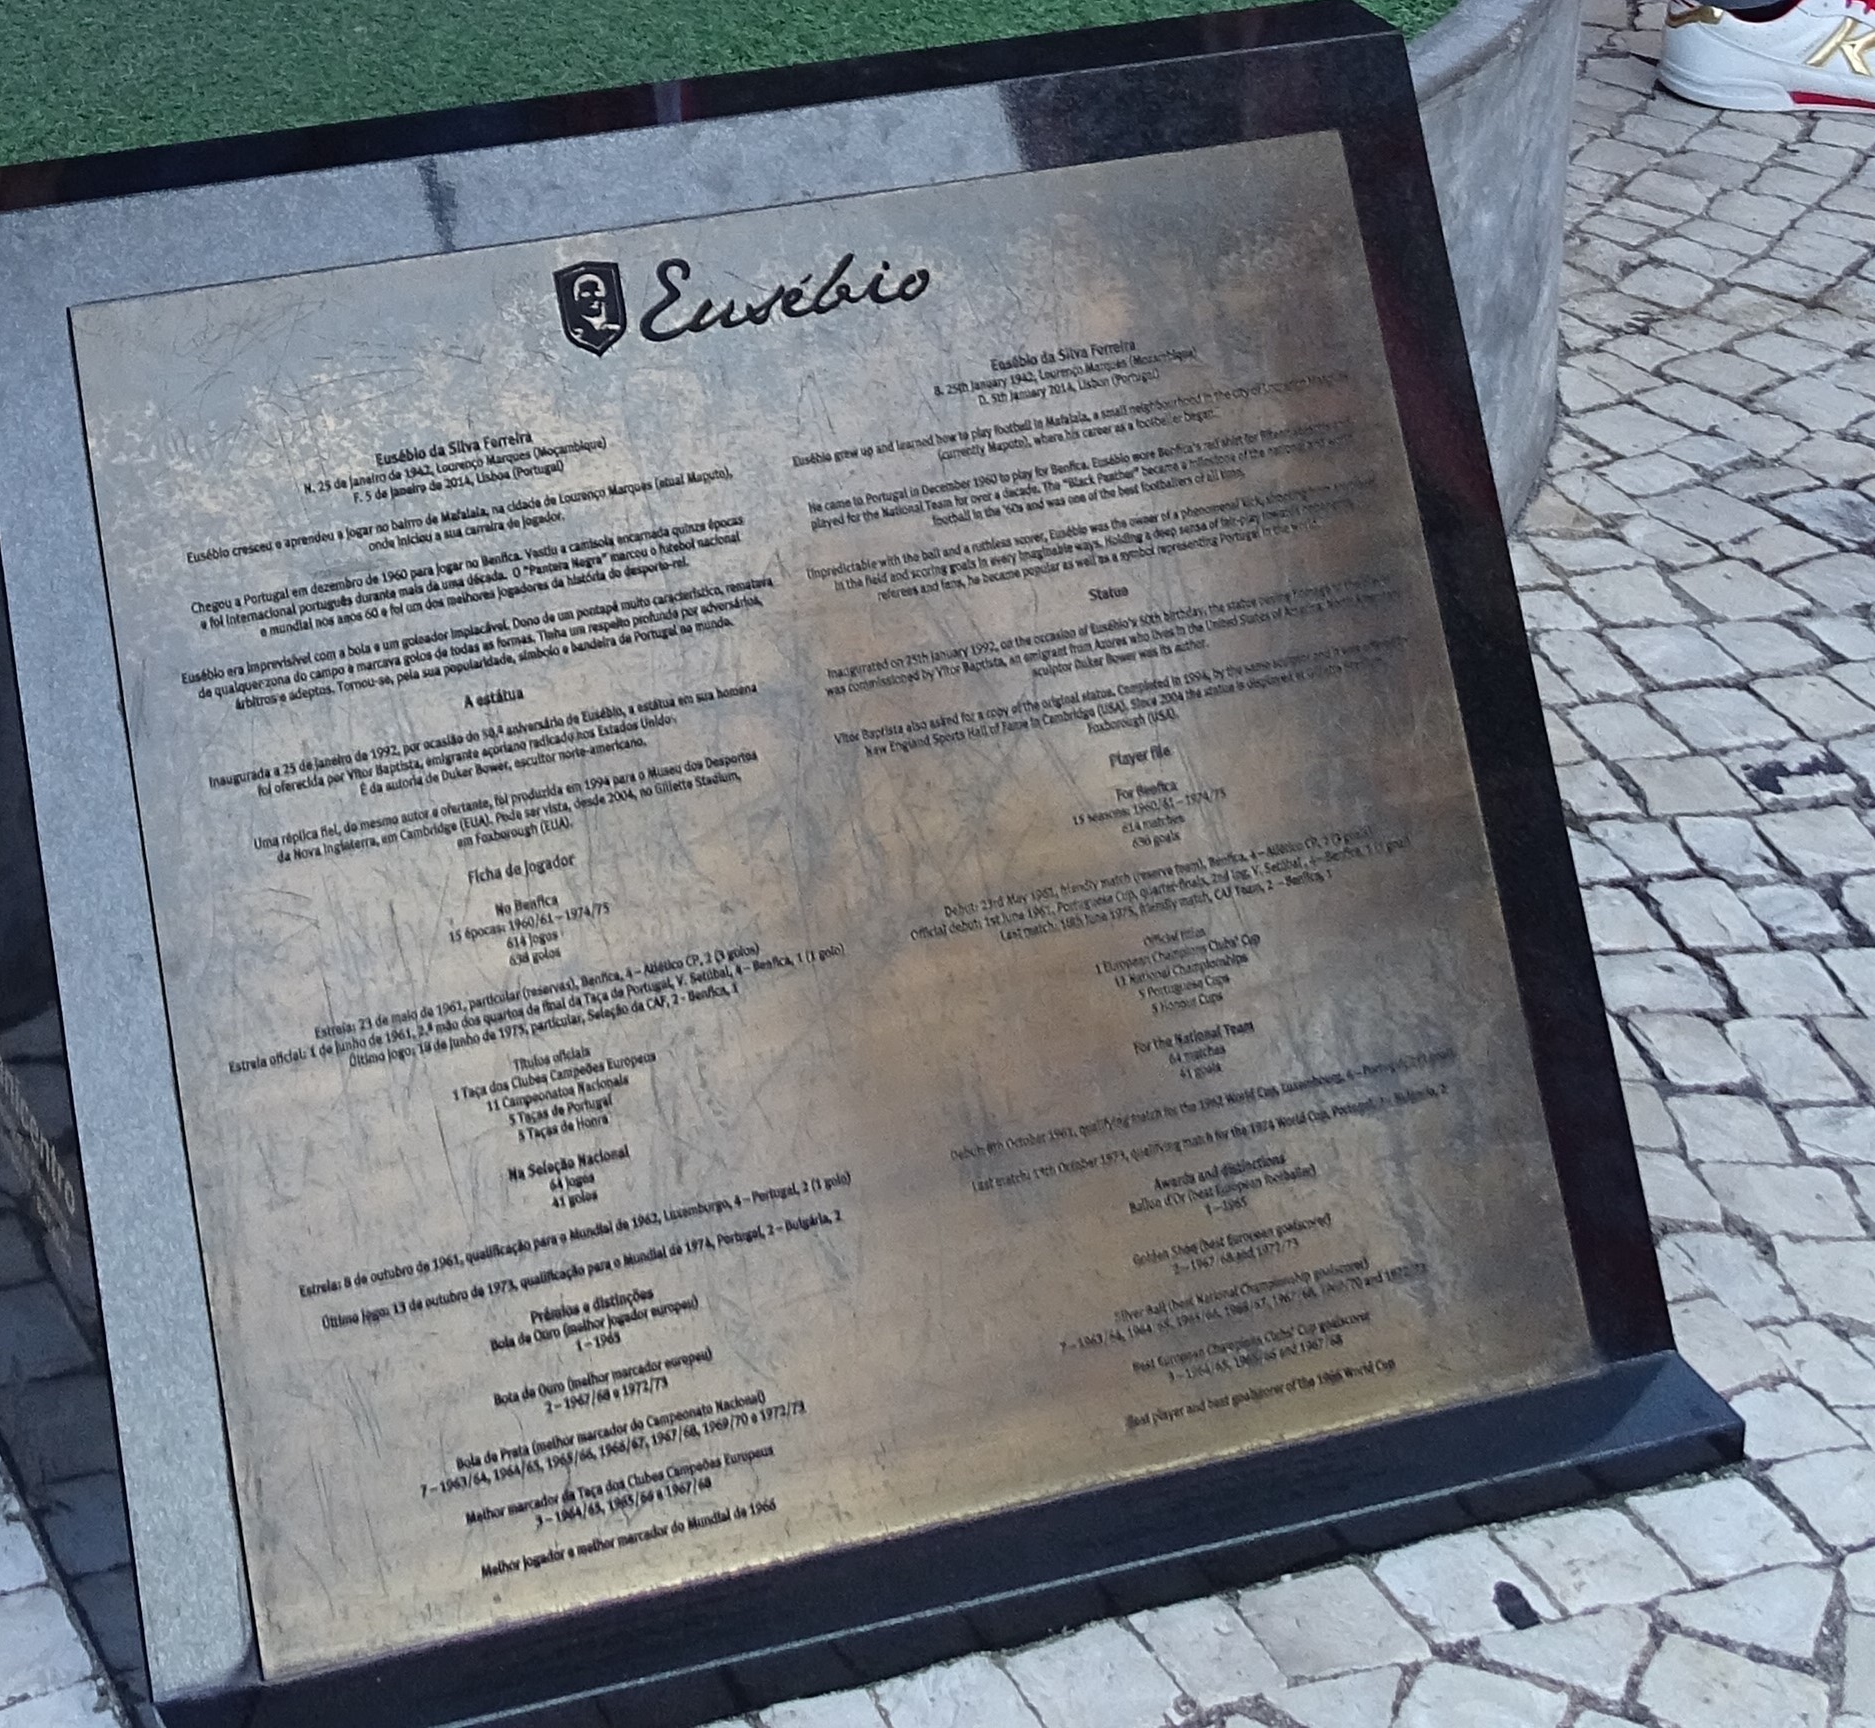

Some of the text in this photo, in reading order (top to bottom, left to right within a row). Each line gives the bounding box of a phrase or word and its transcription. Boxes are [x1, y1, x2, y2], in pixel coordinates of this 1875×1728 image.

[638, 251, 932, 344] Eusébio
[303, 483, 316, 494] N.
[317, 479, 332, 493] 25
[333, 478, 348, 490] de
[348, 473, 387, 488] janeiro
[388, 469, 402, 482] de
[436, 458, 484, 474] Lourenço
[486, 451, 532, 465] Marques
[533, 436, 607, 460] (Moçambique)
[375, 431, 534, 467] Eusébio da Silva Ferreira
[353, 460, 565, 504] F. 5 de janeiro de 2014, Lisboa (Portugal)
[186, 466, 734, 564] Eusébio cresceu e aprendeu a jogar no bairro de Mafalala, na cidade de Lourenço Marques (atual Maputo),
[368, 512, 565, 552] onde iniciou a sua carreira de jogador.
[464, 689, 525, 709] A estátua
[360, 737, 647, 797] É da autoria de Duker Bower, escultor norte-americano.
[467, 853, 575, 886] Ficha de jogador
[494, 894, 559, 917] No Benfica
[506, 931, 559, 949] 614 jogos
[512, 1045, 591, 1072] Títulos oficiais
[487, 1074, 630, 1112] 11 Campeonatos Nacionais
[507, 1143, 631, 1182] Na Seleção Nacional
[530, 1288, 655, 1325] Prémios e distinções
[481, 1559, 520, 1579] Melhor
[522, 1549, 565, 1572] jogador
[567, 1547, 575, 1559] e
[576, 1538, 615, 1556] melhor
[616, 1525, 668, 1548] marcador
[670, 1519, 685, 1535] do
[687, 1507, 732, 1531] Mundial
[733, 1506, 748, 1520] de
